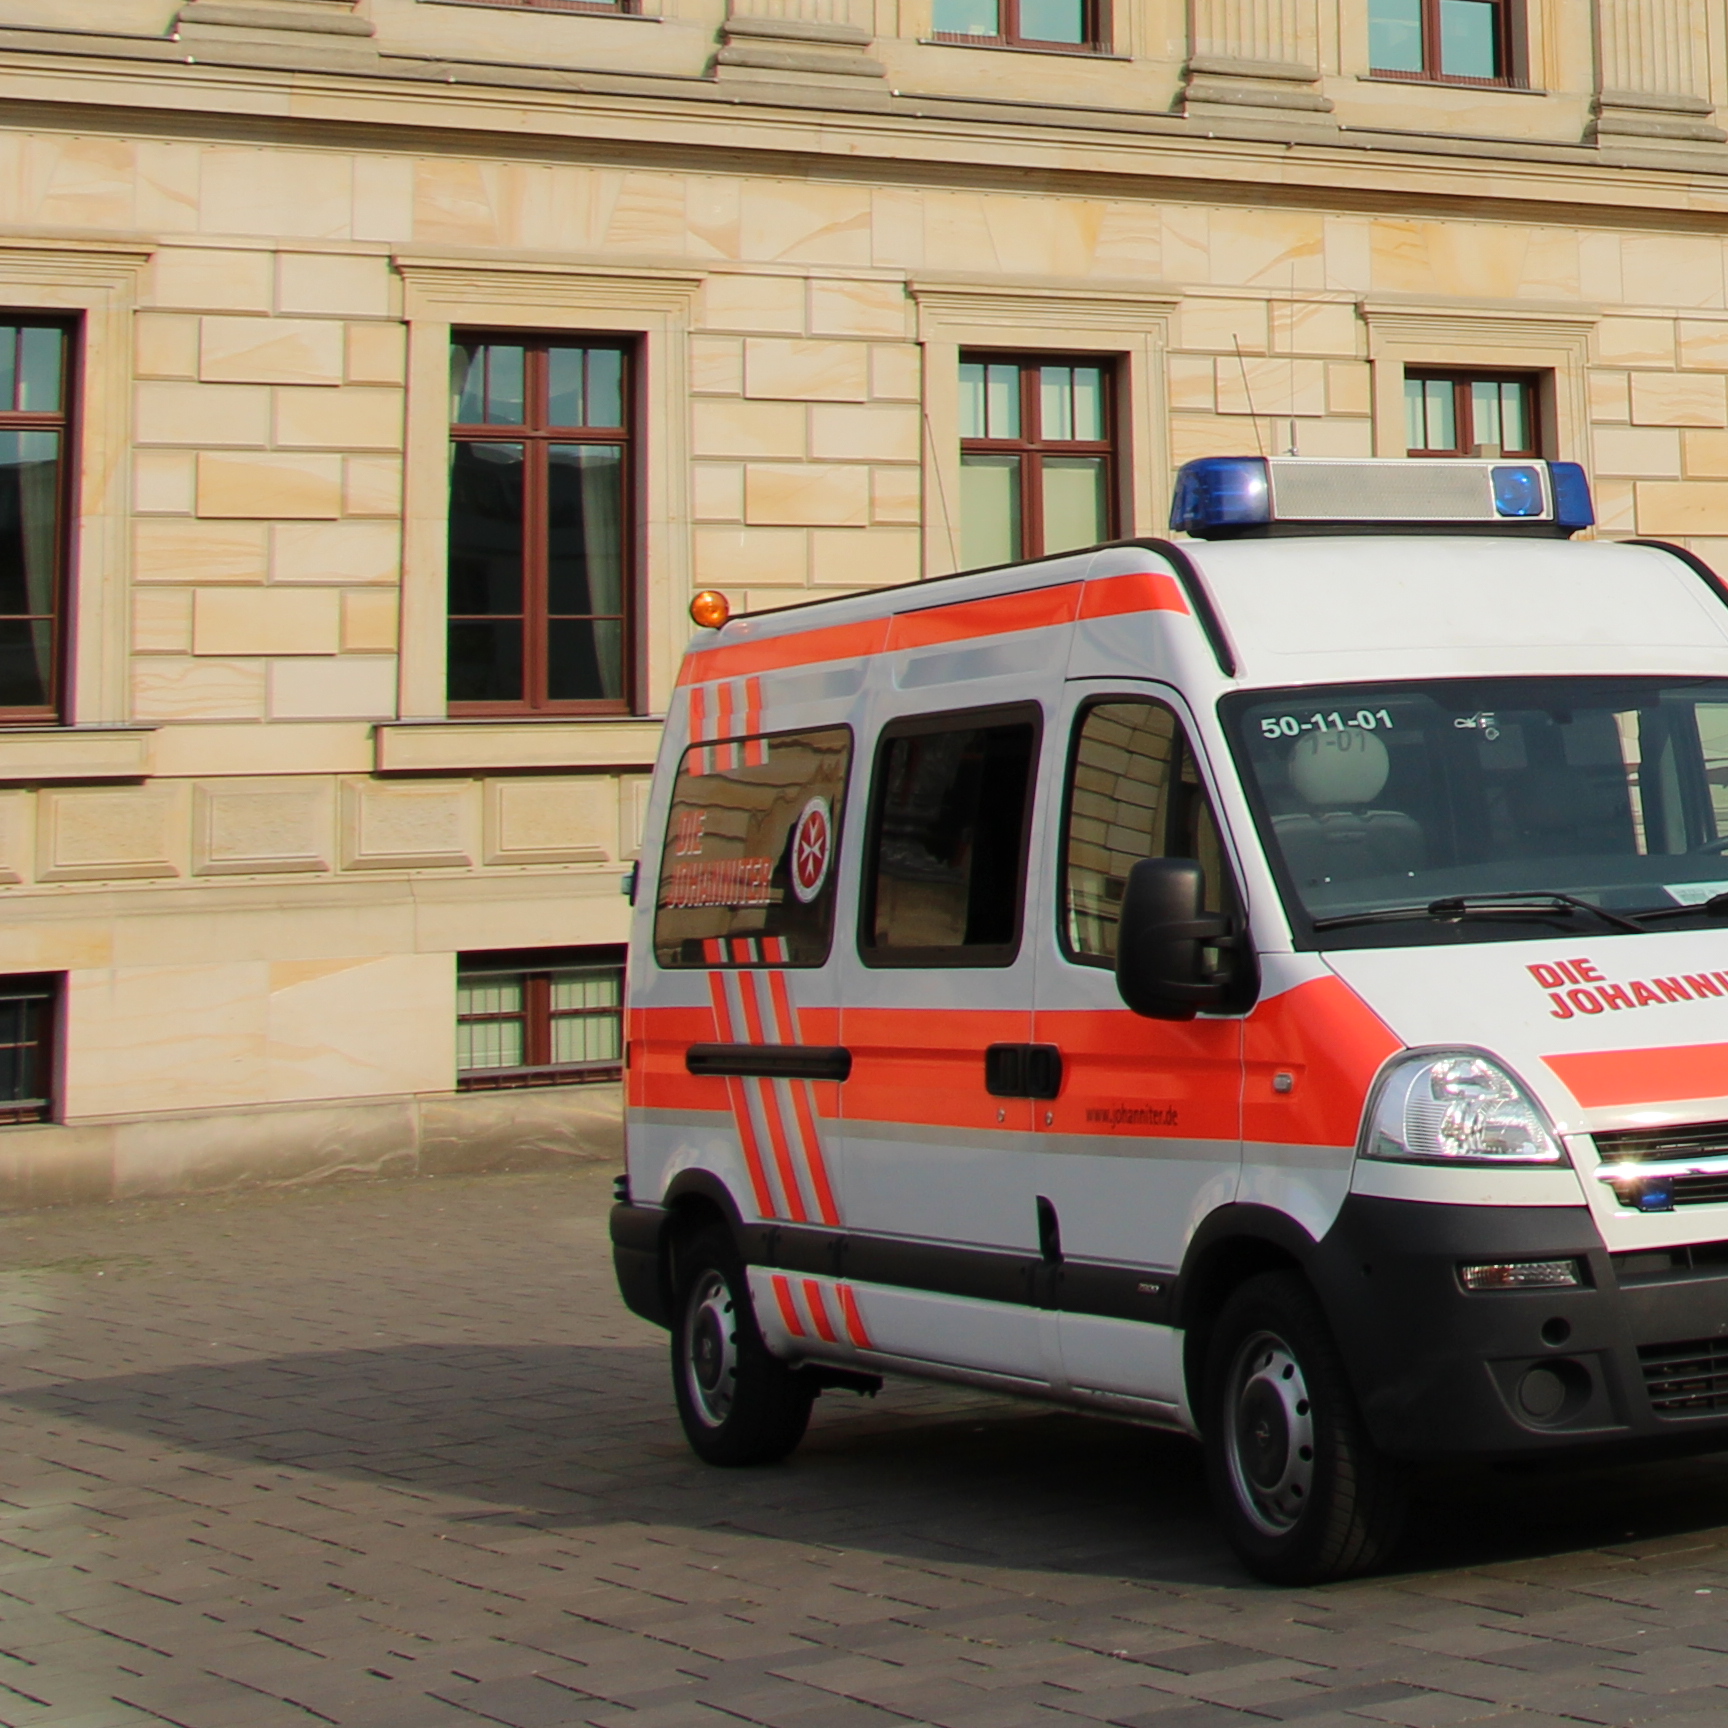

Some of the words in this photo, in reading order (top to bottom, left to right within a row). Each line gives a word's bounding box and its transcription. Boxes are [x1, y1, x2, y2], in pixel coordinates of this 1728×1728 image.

[1260, 708, 1394, 739] 50-11-01
[675, 809, 707, 857] DIE
[666, 856, 774, 910] JOHANNITER
[1526, 957, 1607, 989] DIE
[1085, 1103, 1178, 1129] www.johanniter.de
